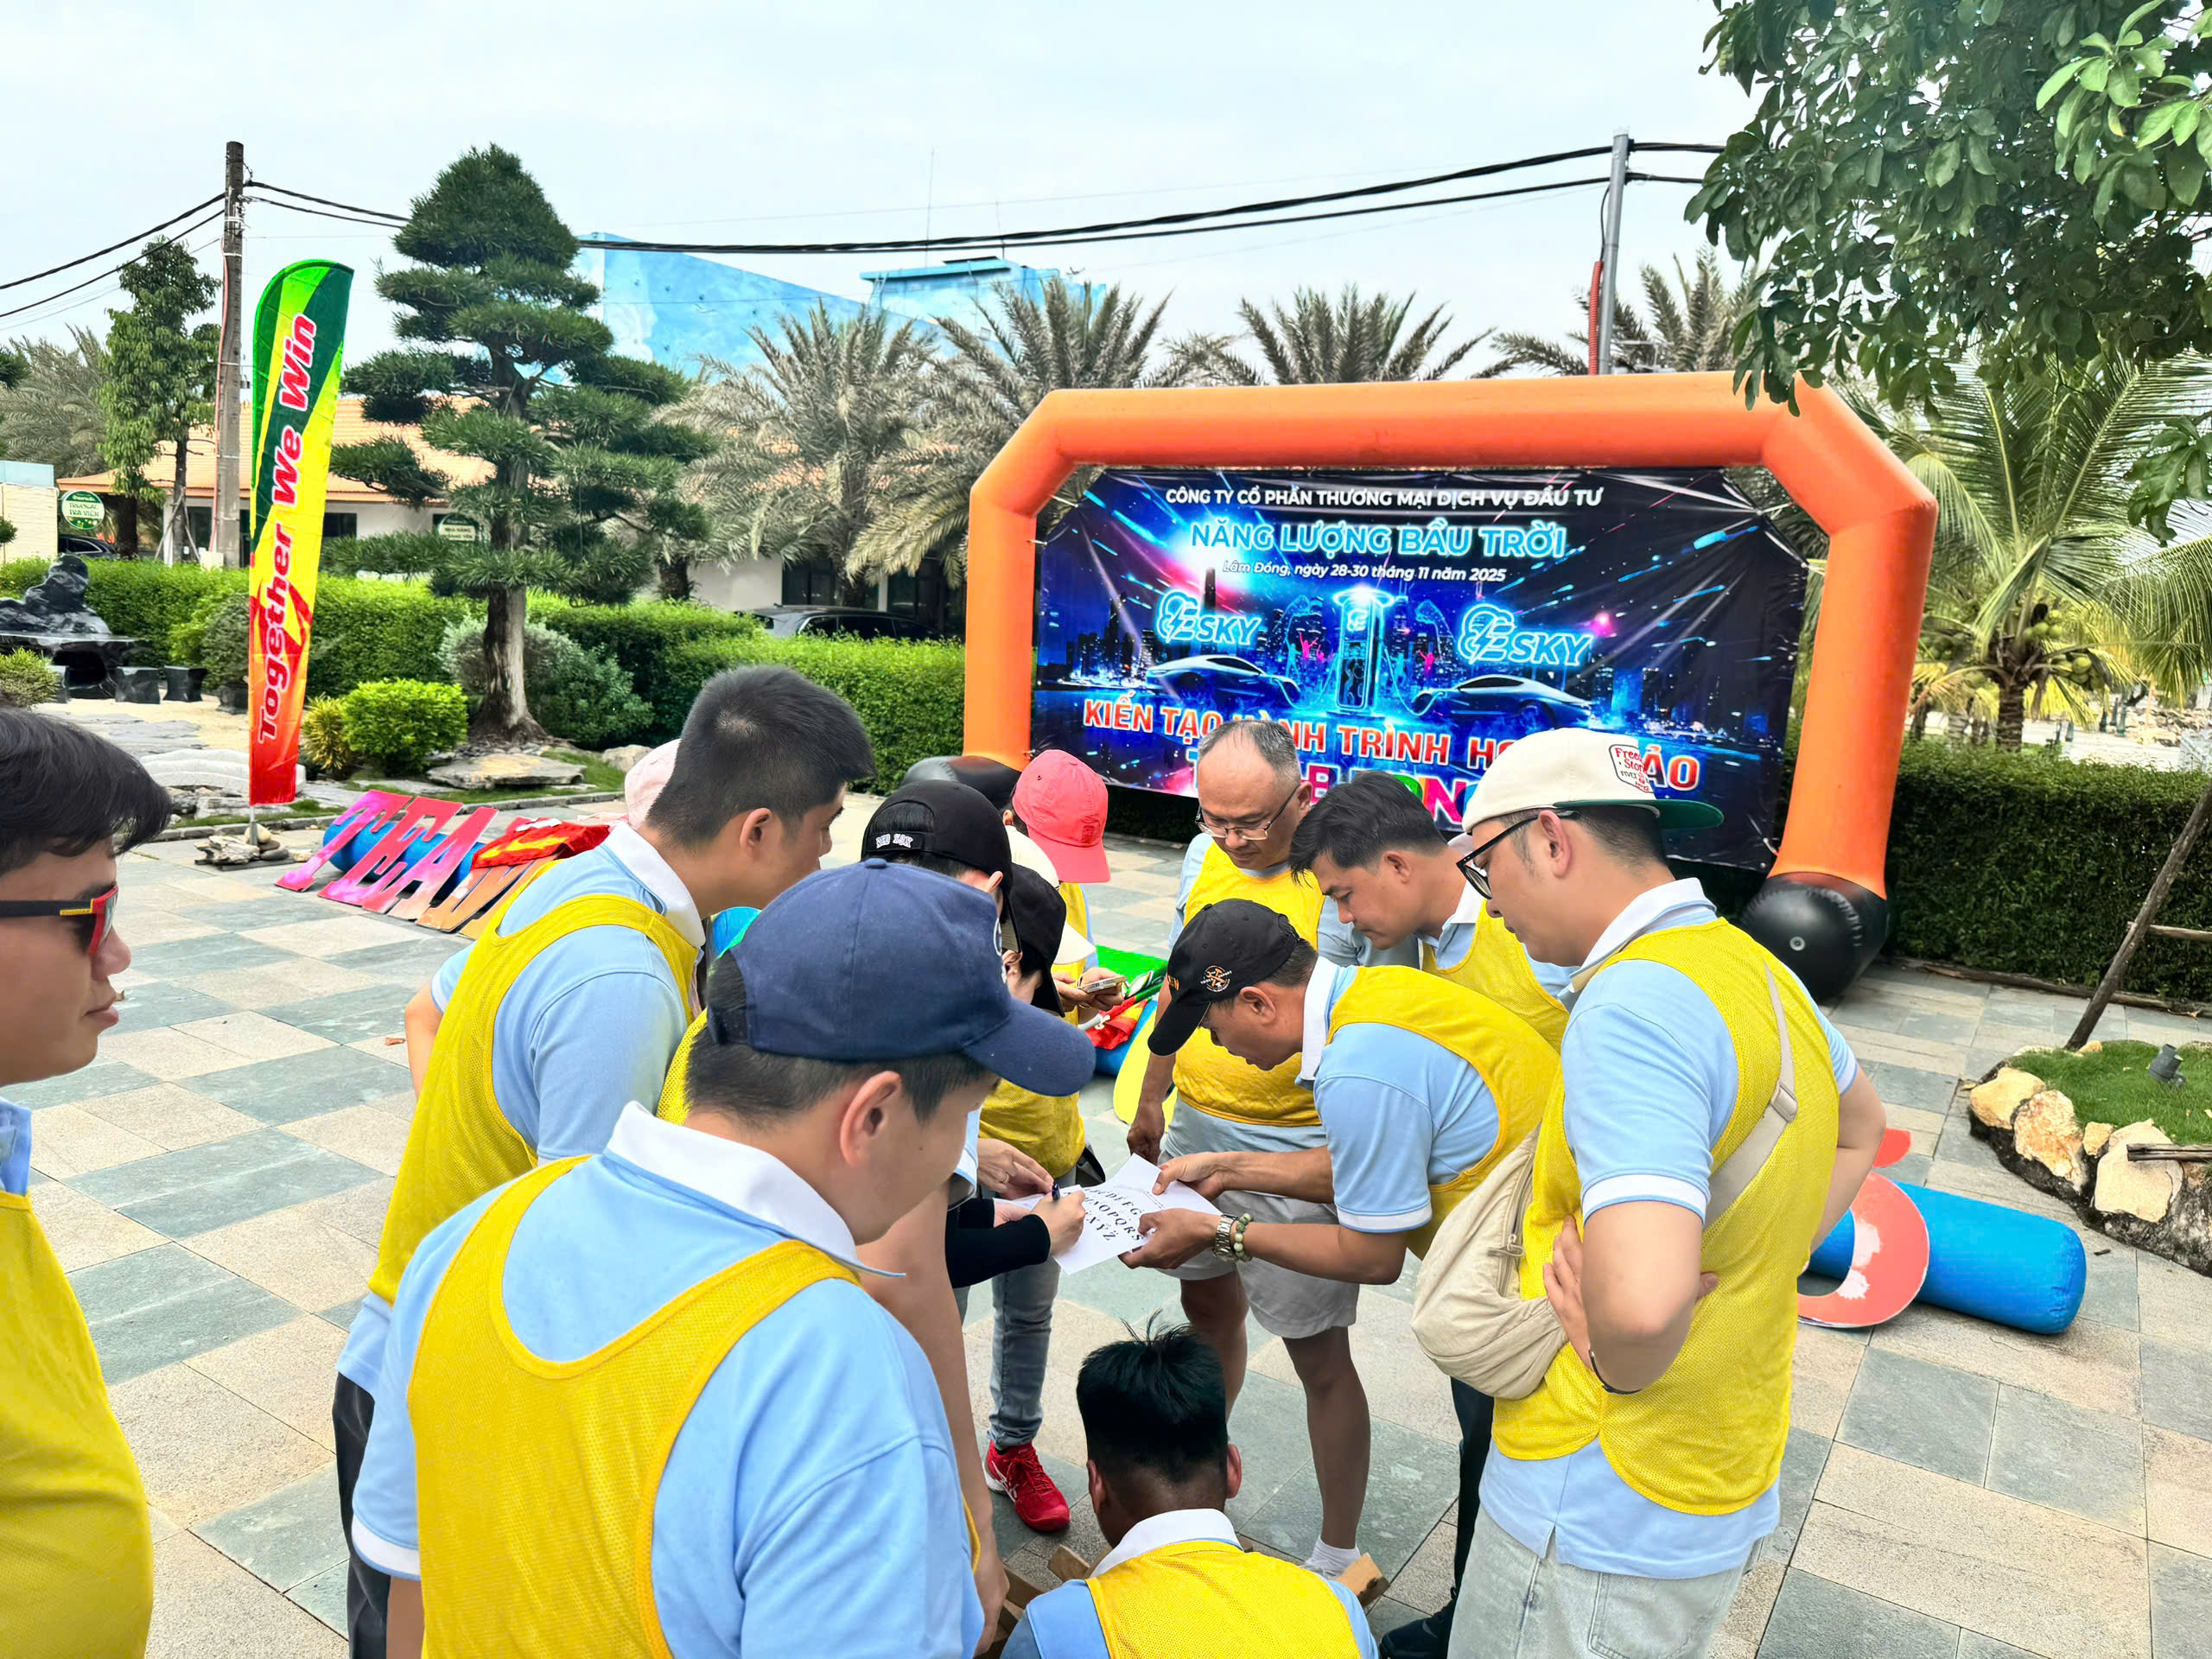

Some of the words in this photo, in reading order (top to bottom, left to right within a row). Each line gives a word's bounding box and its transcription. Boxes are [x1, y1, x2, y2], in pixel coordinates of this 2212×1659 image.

[279, 312, 316, 413] Win
[272, 425, 302, 507] We
[1166, 486, 1210, 504] CÔNG
[1214, 490, 1236, 504] TY
[1236, 485, 1261, 504] CỔ
[1265, 484, 1312, 505] PHẦN
[1316, 488, 1392, 505] THƯƠNG
[1396, 491, 1433, 510] MẠI
[1437, 491, 1484, 510] DỊCH
[1489, 491, 1520, 510] VỤ
[1522, 485, 1568, 505] ĐẦU
[1573, 487, 1605, 506] TƯ
[1191, 518, 1274, 550] NĂNG
[1280, 519, 1392, 560] LƯỢNG
[1396, 517, 1472, 556] BẦU
[1478, 520, 1567, 558] TRỜI
[1223, 560, 1250, 574] Lâm
[1294, 564, 1327, 579] ngày
[1331, 564, 1369, 577] 28-30
[1371, 564, 1415, 581] tháng
[1418, 566, 1428, 579] 11
[1431, 564, 1466, 580] năm
[1469, 568, 1507, 582] 2025
[258, 518, 293, 744] Together
[1084, 690, 1154, 734] KIẾN
[1160, 705, 1224, 747] TẠO
[1337, 723, 1452, 766] TRÌNH
[1644, 744, 1700, 791] ẢO
